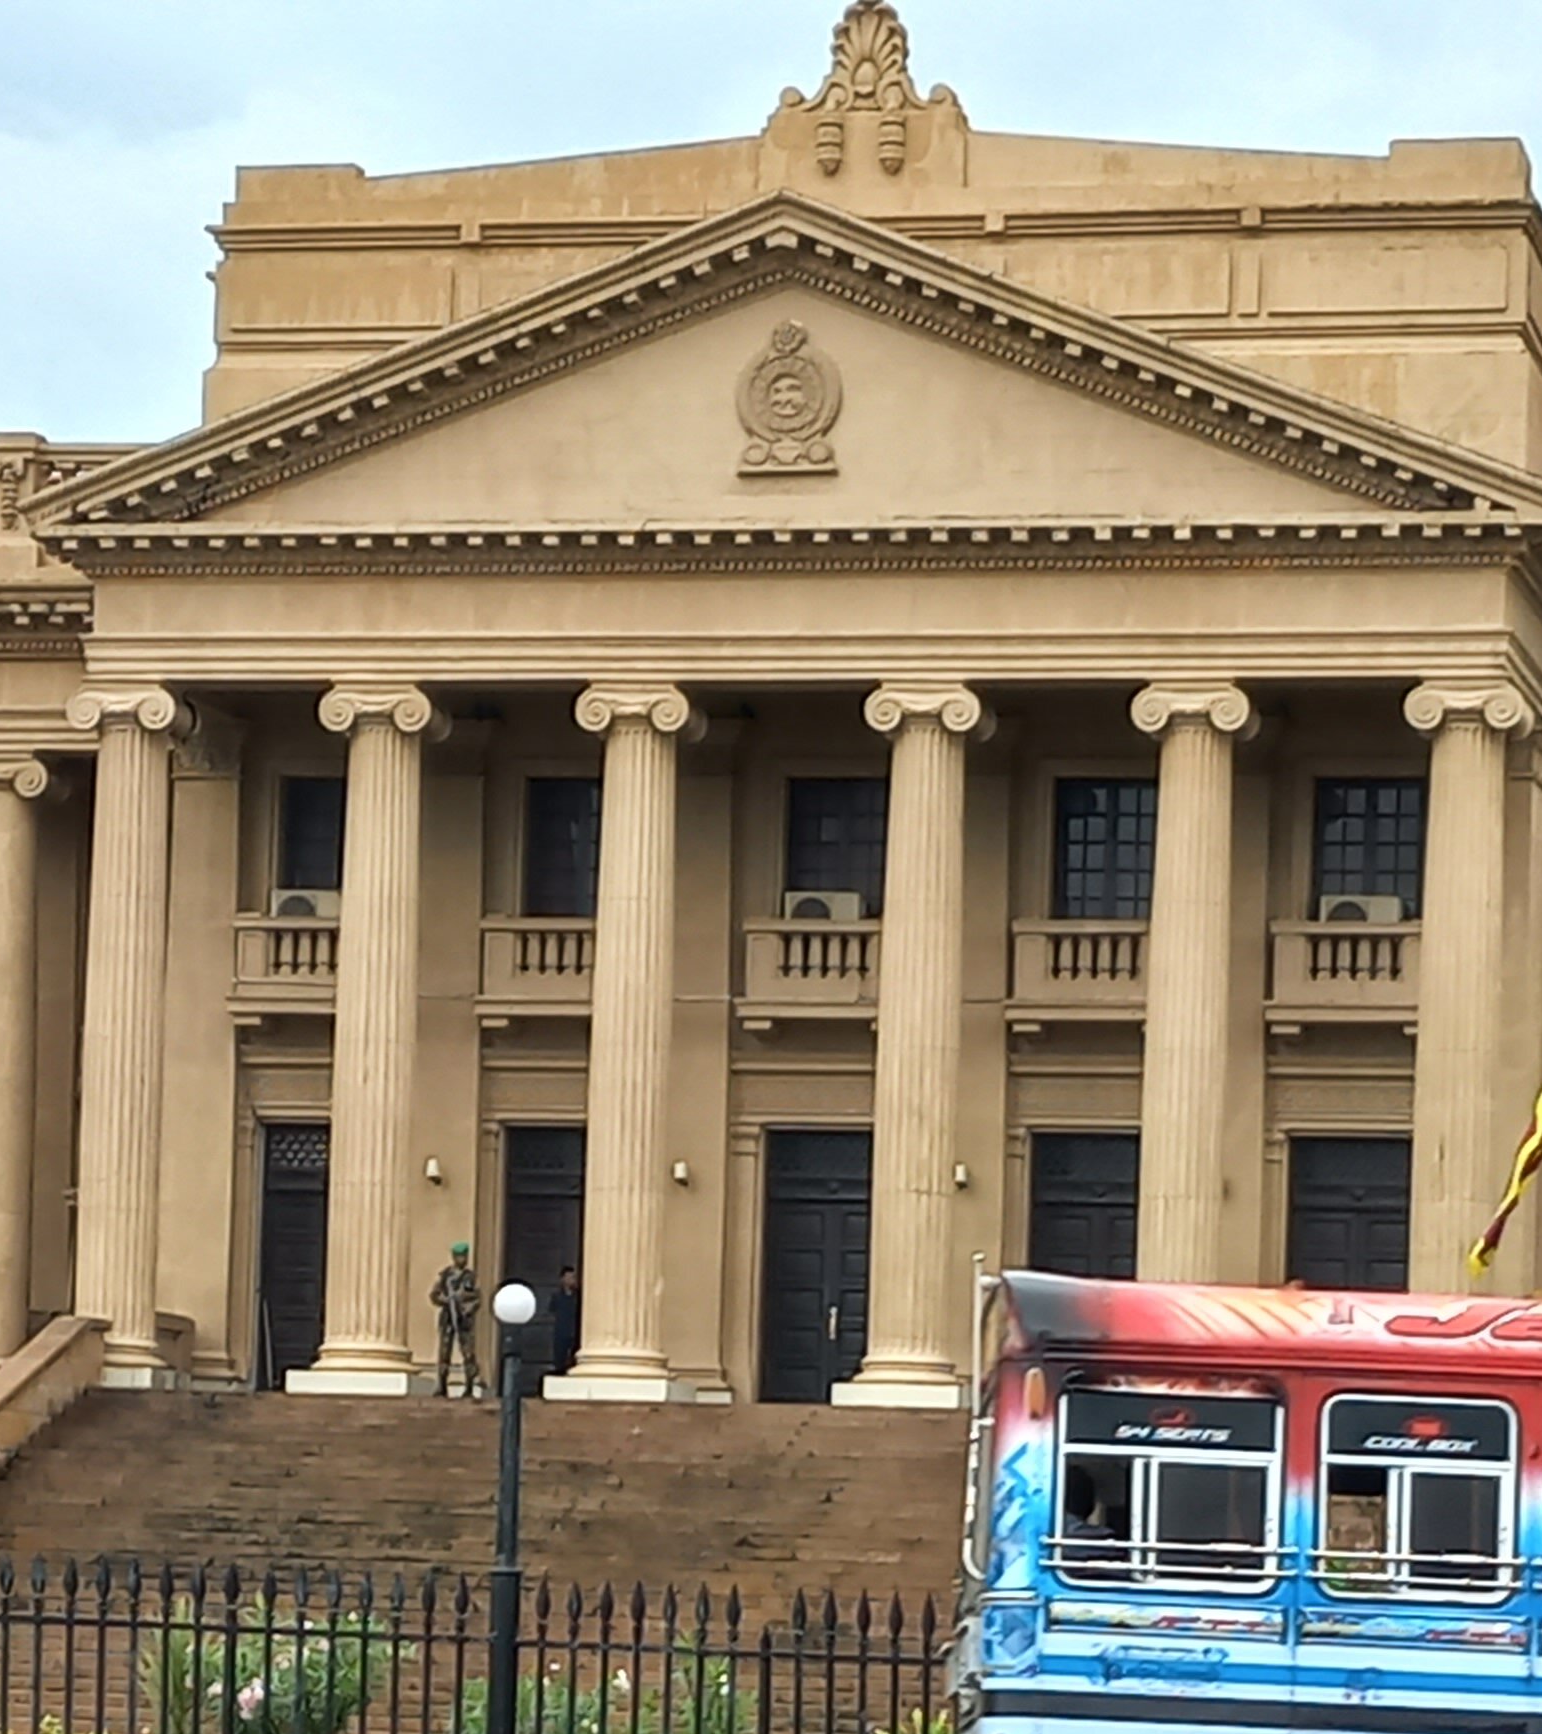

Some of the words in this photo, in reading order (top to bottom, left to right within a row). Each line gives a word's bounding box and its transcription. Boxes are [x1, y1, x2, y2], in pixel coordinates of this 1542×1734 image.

[1152, 1426, 1232, 1442] SEATS
[1363, 1436, 1424, 1450] COOL
[1426, 1439, 1478, 1452] BOX
